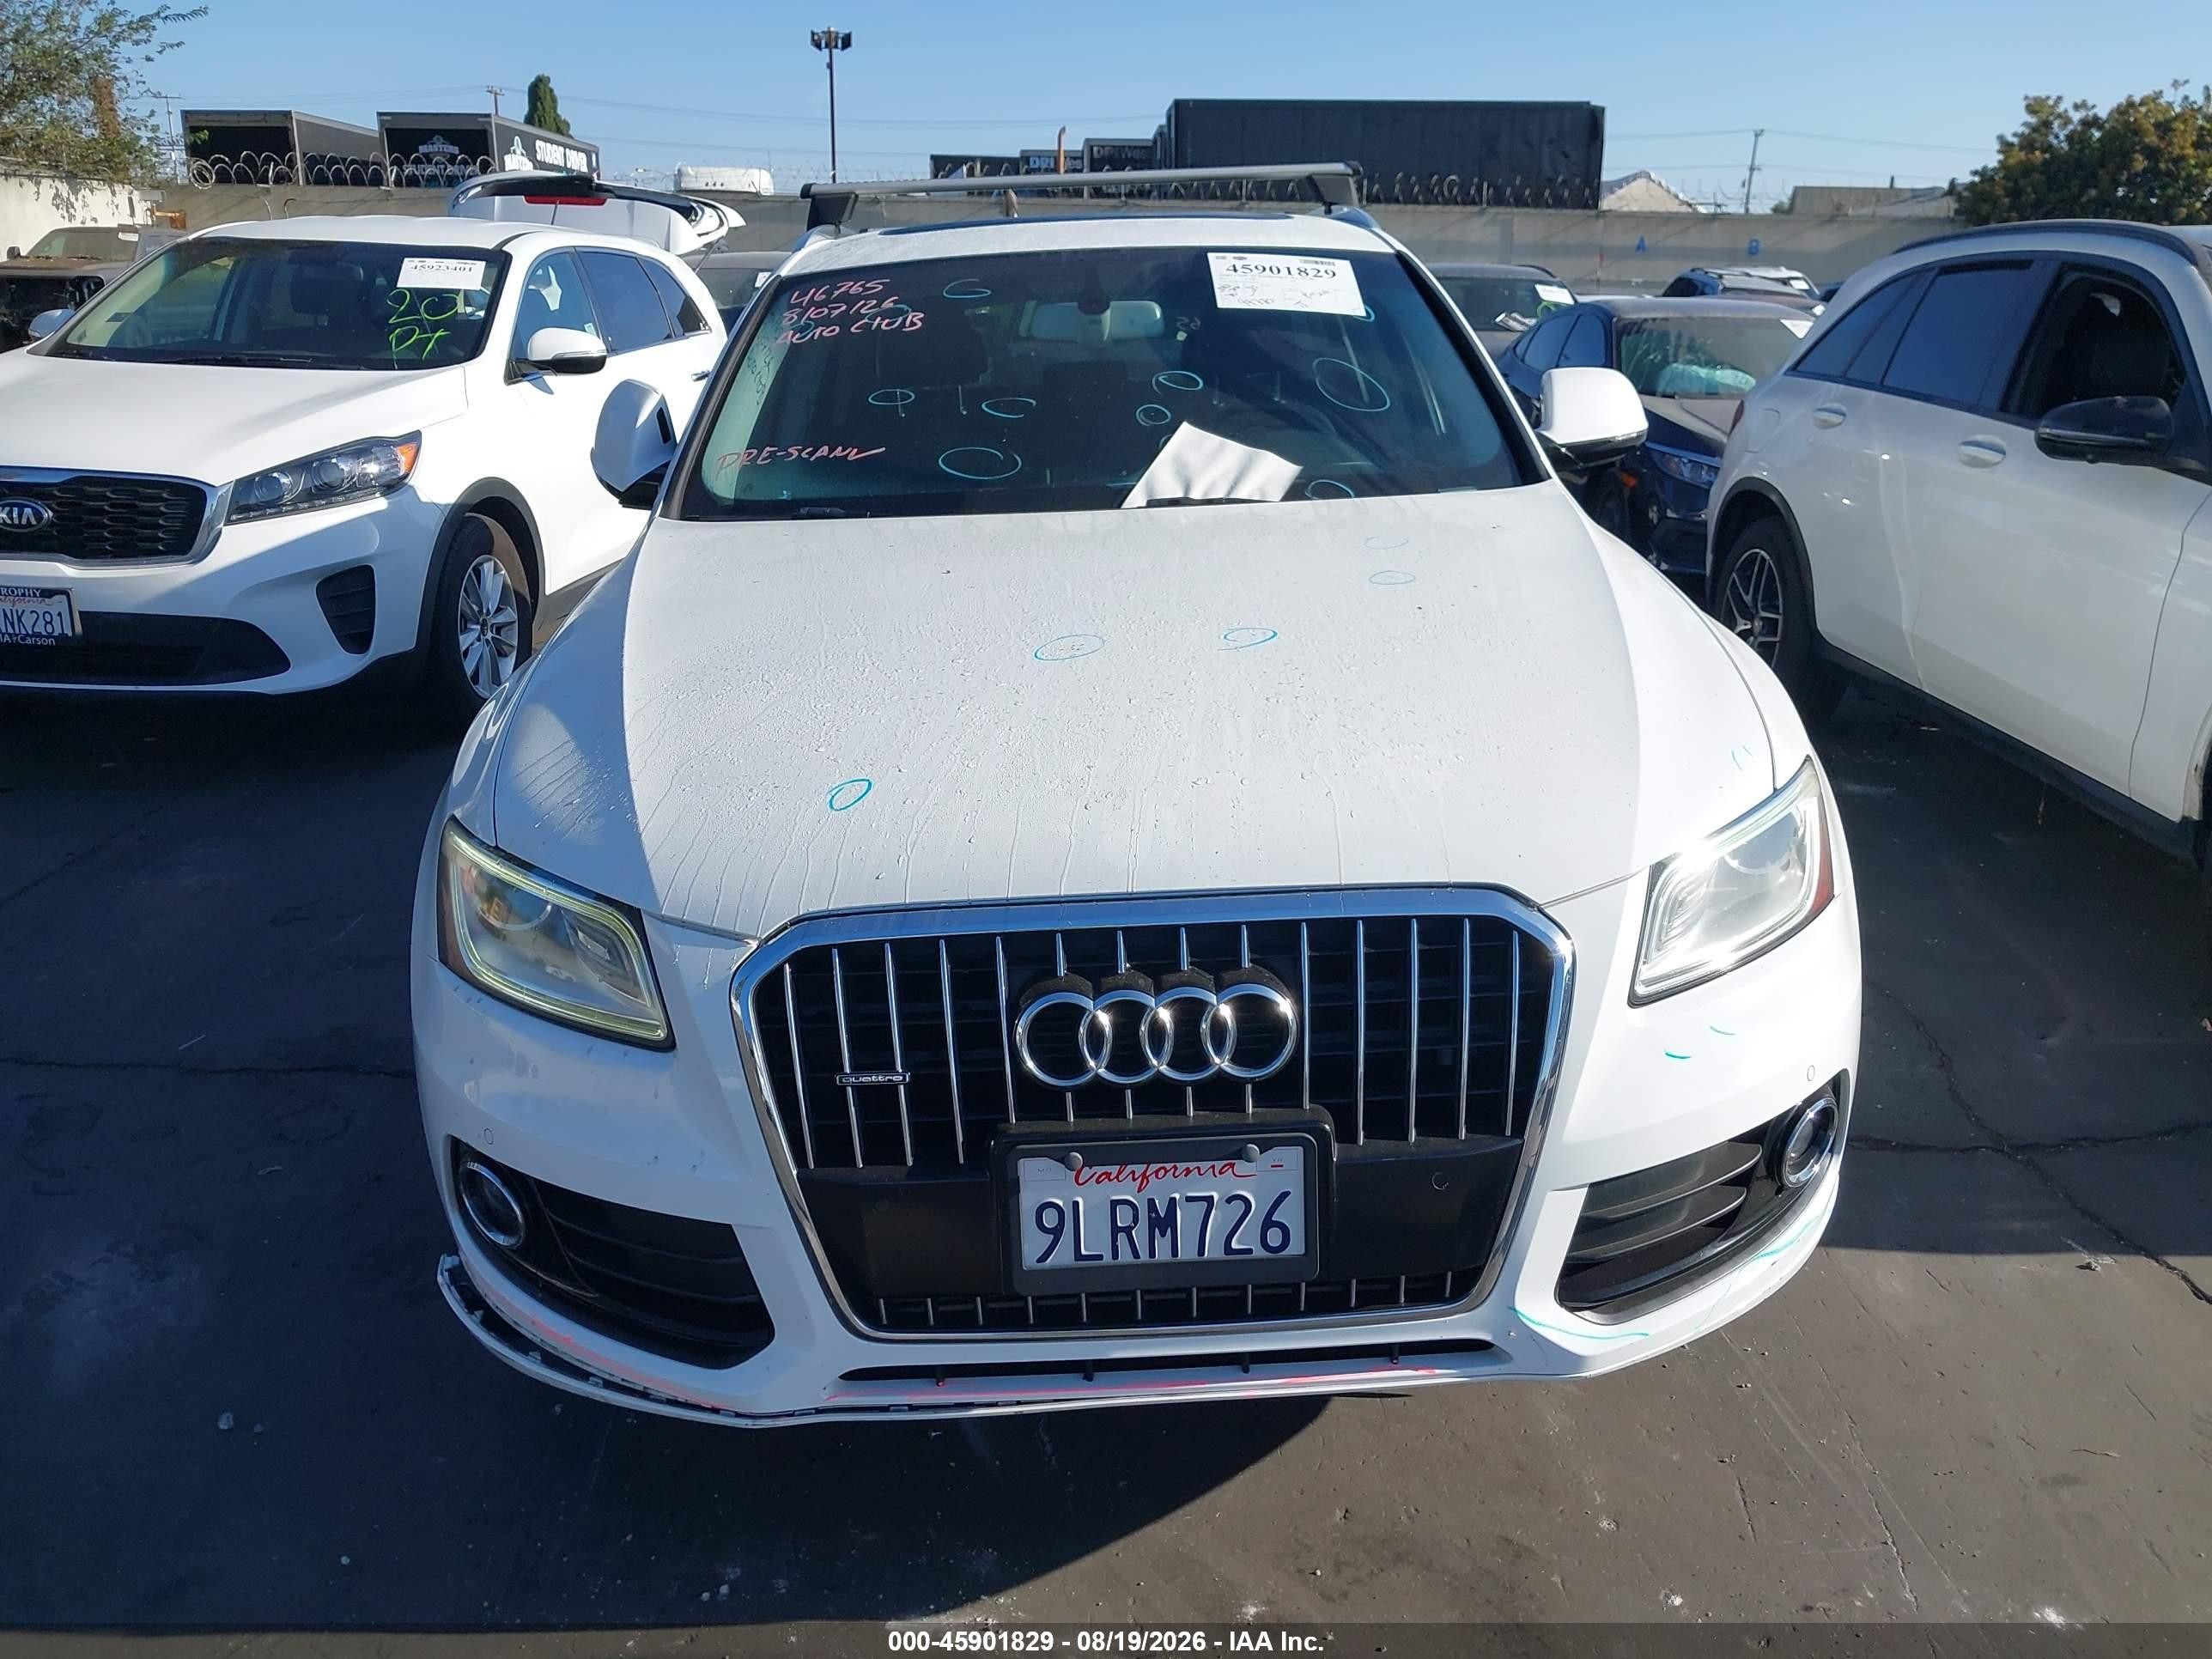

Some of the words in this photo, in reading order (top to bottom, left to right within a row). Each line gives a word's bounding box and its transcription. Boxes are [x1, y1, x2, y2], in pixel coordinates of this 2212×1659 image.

[536, 139, 565, 167] STUDENT
[566, 148, 588, 172] DRIVER
[1635, 235, 1646, 253] A
[1226, 264, 1336, 278] 45901829
[791, 279, 890, 306] 46765
[0, 507, 37, 525] KIA
[0, 587, 41, 598] ROPHY
[0, 608, 69, 636] NK281
[18, 635, 56, 646] Carson
[1073, 1160, 1257, 1193] California
[1034, 1190, 1292, 1264] 9LRM726
